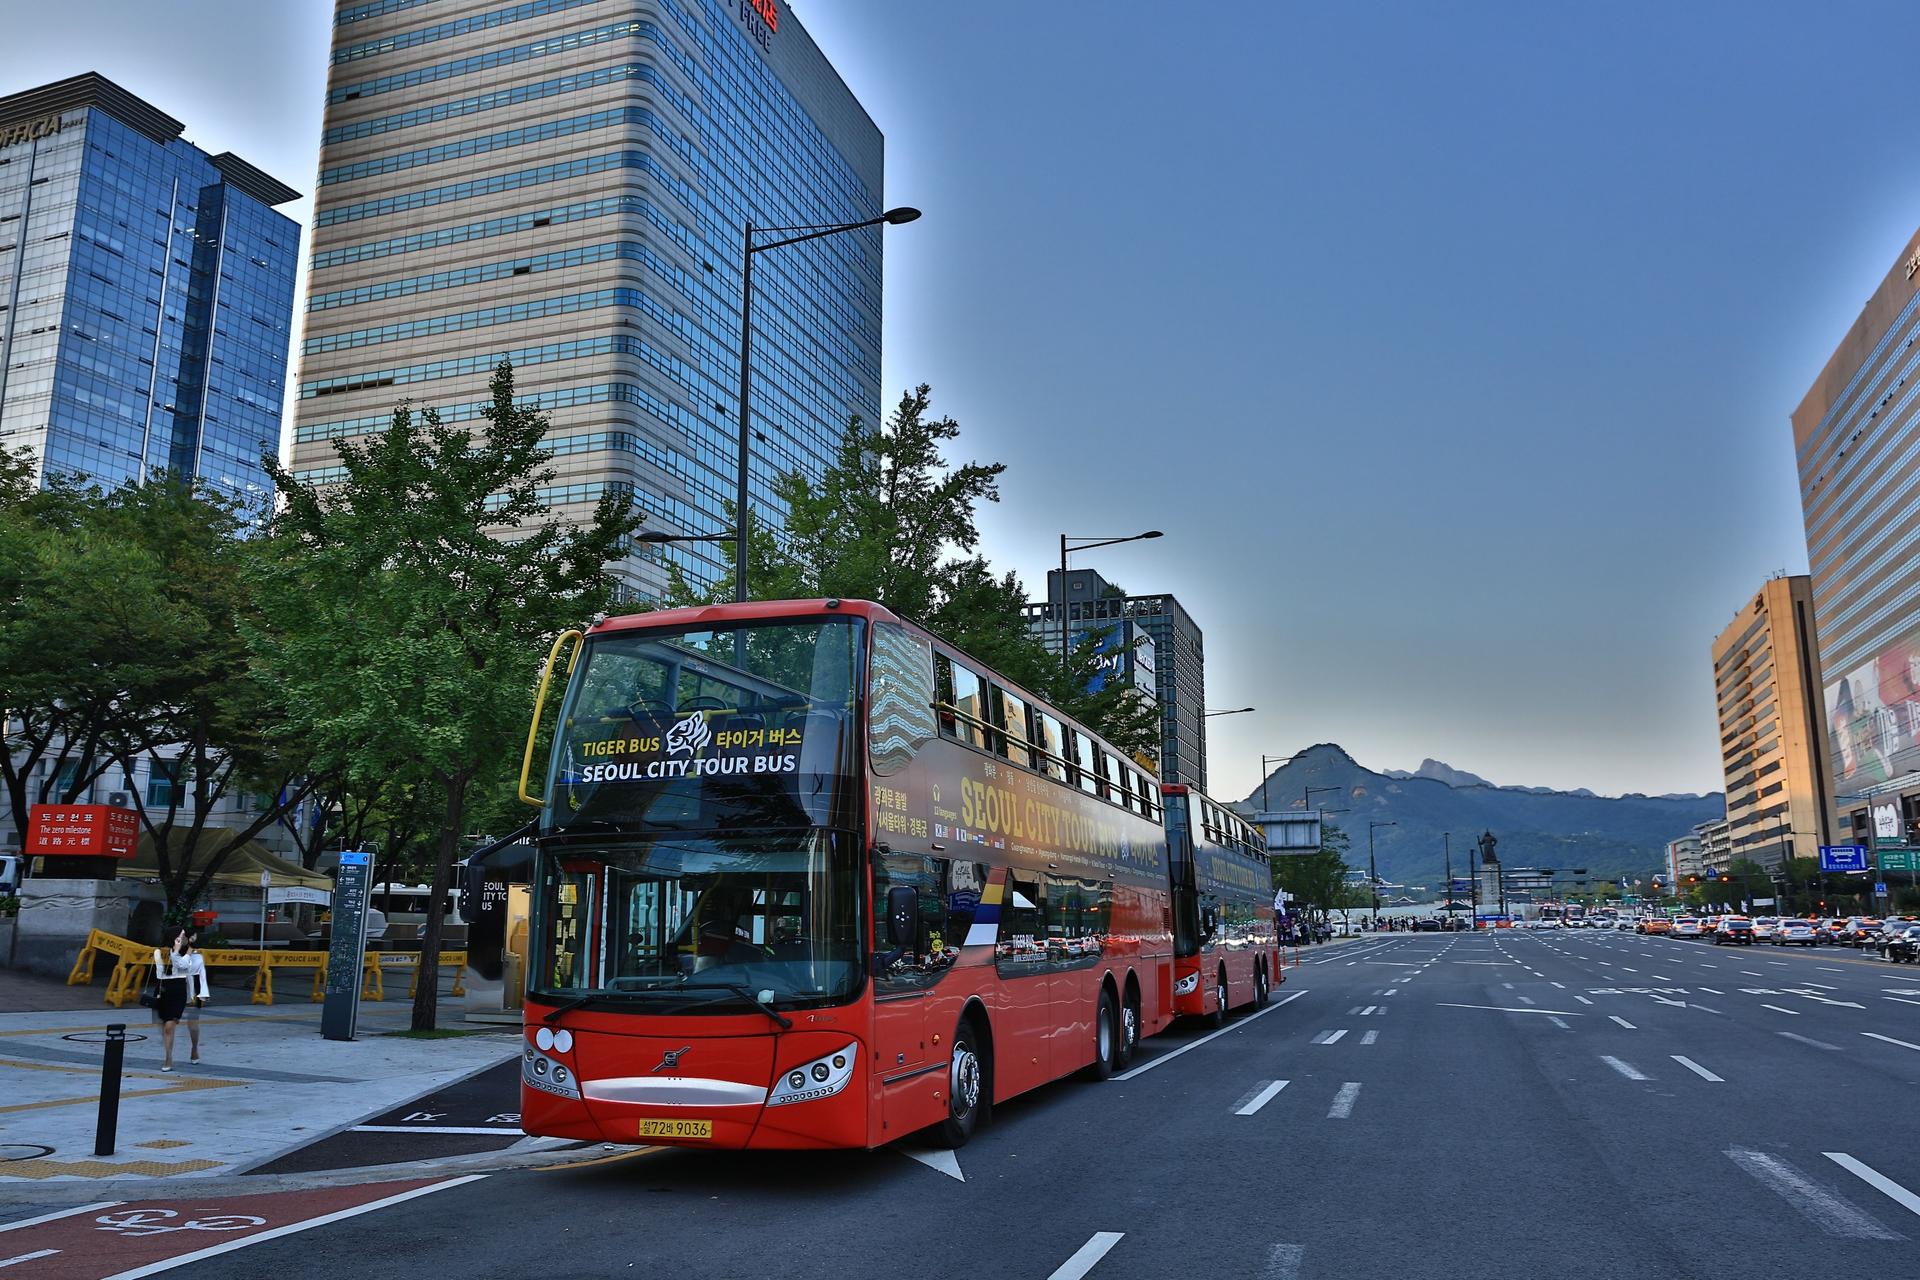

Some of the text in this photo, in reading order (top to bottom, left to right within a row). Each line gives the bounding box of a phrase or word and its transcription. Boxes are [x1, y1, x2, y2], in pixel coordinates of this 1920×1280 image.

[740, 1, 770, 55] FREE
[582, 737, 660, 757] TIGER BUS
[716, 728, 802, 748] 타이거 버스
[582, 754, 796, 783] SEOUL CITY TOUR BUS
[874, 785, 908, 812] 광화문 출발
[41, 813, 94, 823] 도로원표
[960, 776, 1023, 838] SEOUL
[1025, 802, 1060, 847] CITY
[1060, 811, 1097, 855] TOUR
[40, 825, 51, 834] The
[65, 826, 92, 835] milestone
[676, 1122, 708, 1136] 9036
